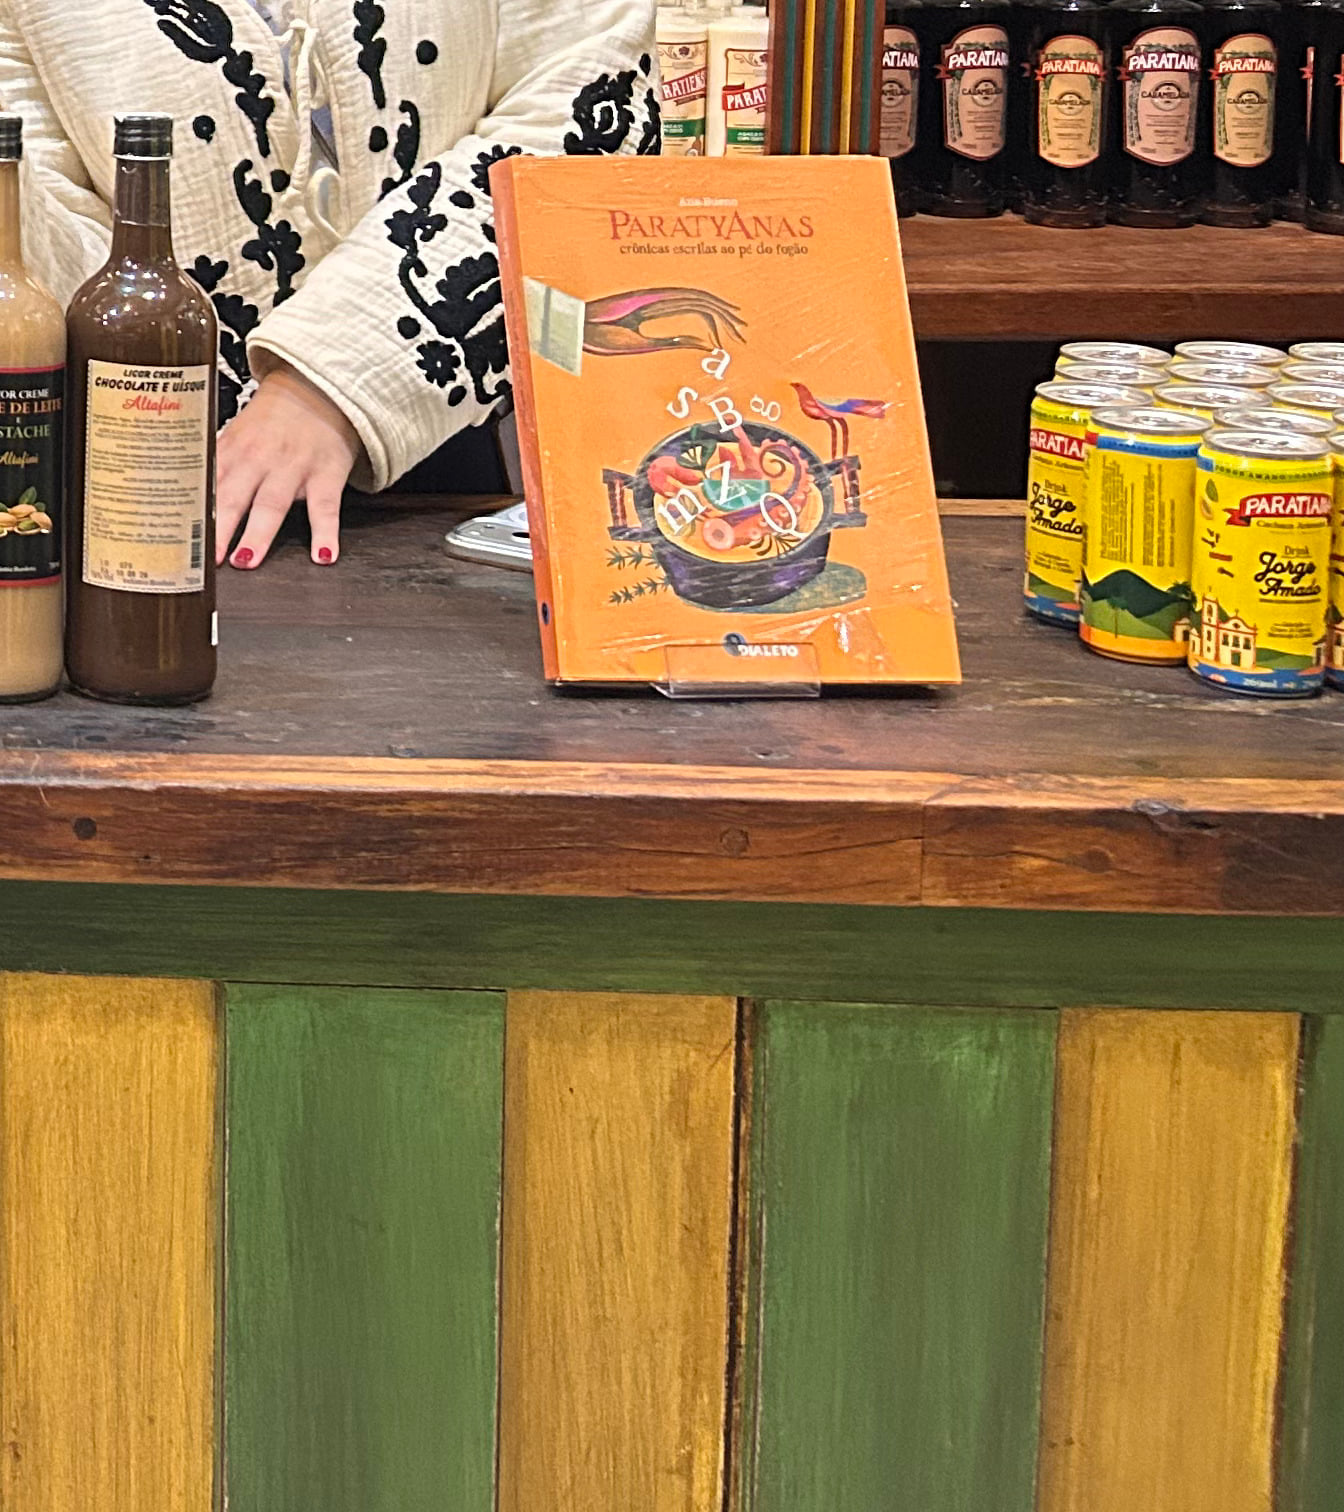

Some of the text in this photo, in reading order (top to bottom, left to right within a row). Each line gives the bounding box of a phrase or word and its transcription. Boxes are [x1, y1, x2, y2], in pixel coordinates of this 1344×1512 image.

[1042, 61, 1100, 75] PARATIANA
[1129, 53, 1199, 71] PARATIANA
[620, 243, 669, 254] crônicas
[721, 246, 735, 254] ao
[739, 244, 752, 258] pé
[757, 242, 773, 254] do
[777, 243, 808, 256] fogão
[701, 346, 731, 380] a
[123, 369, 184, 379] LICOR CREME
[19, 389, 49, 398] CREME
[95, 377, 159, 392] CHOCOLATE
[162, 383, 169, 392] E
[10, 401, 31, 414] DE
[34, 398, 62, 413] LEITE
[122, 395, 181, 415] Altafini
[709, 396, 744, 432] B
[1030, 482, 1076, 518] Jorge
[1031, 506, 1083, 534] Amado
[1254, 551, 1316, 584] Jorge
[1259, 578, 1321, 597] Amado
[738, 644, 799, 657] DIALETO
